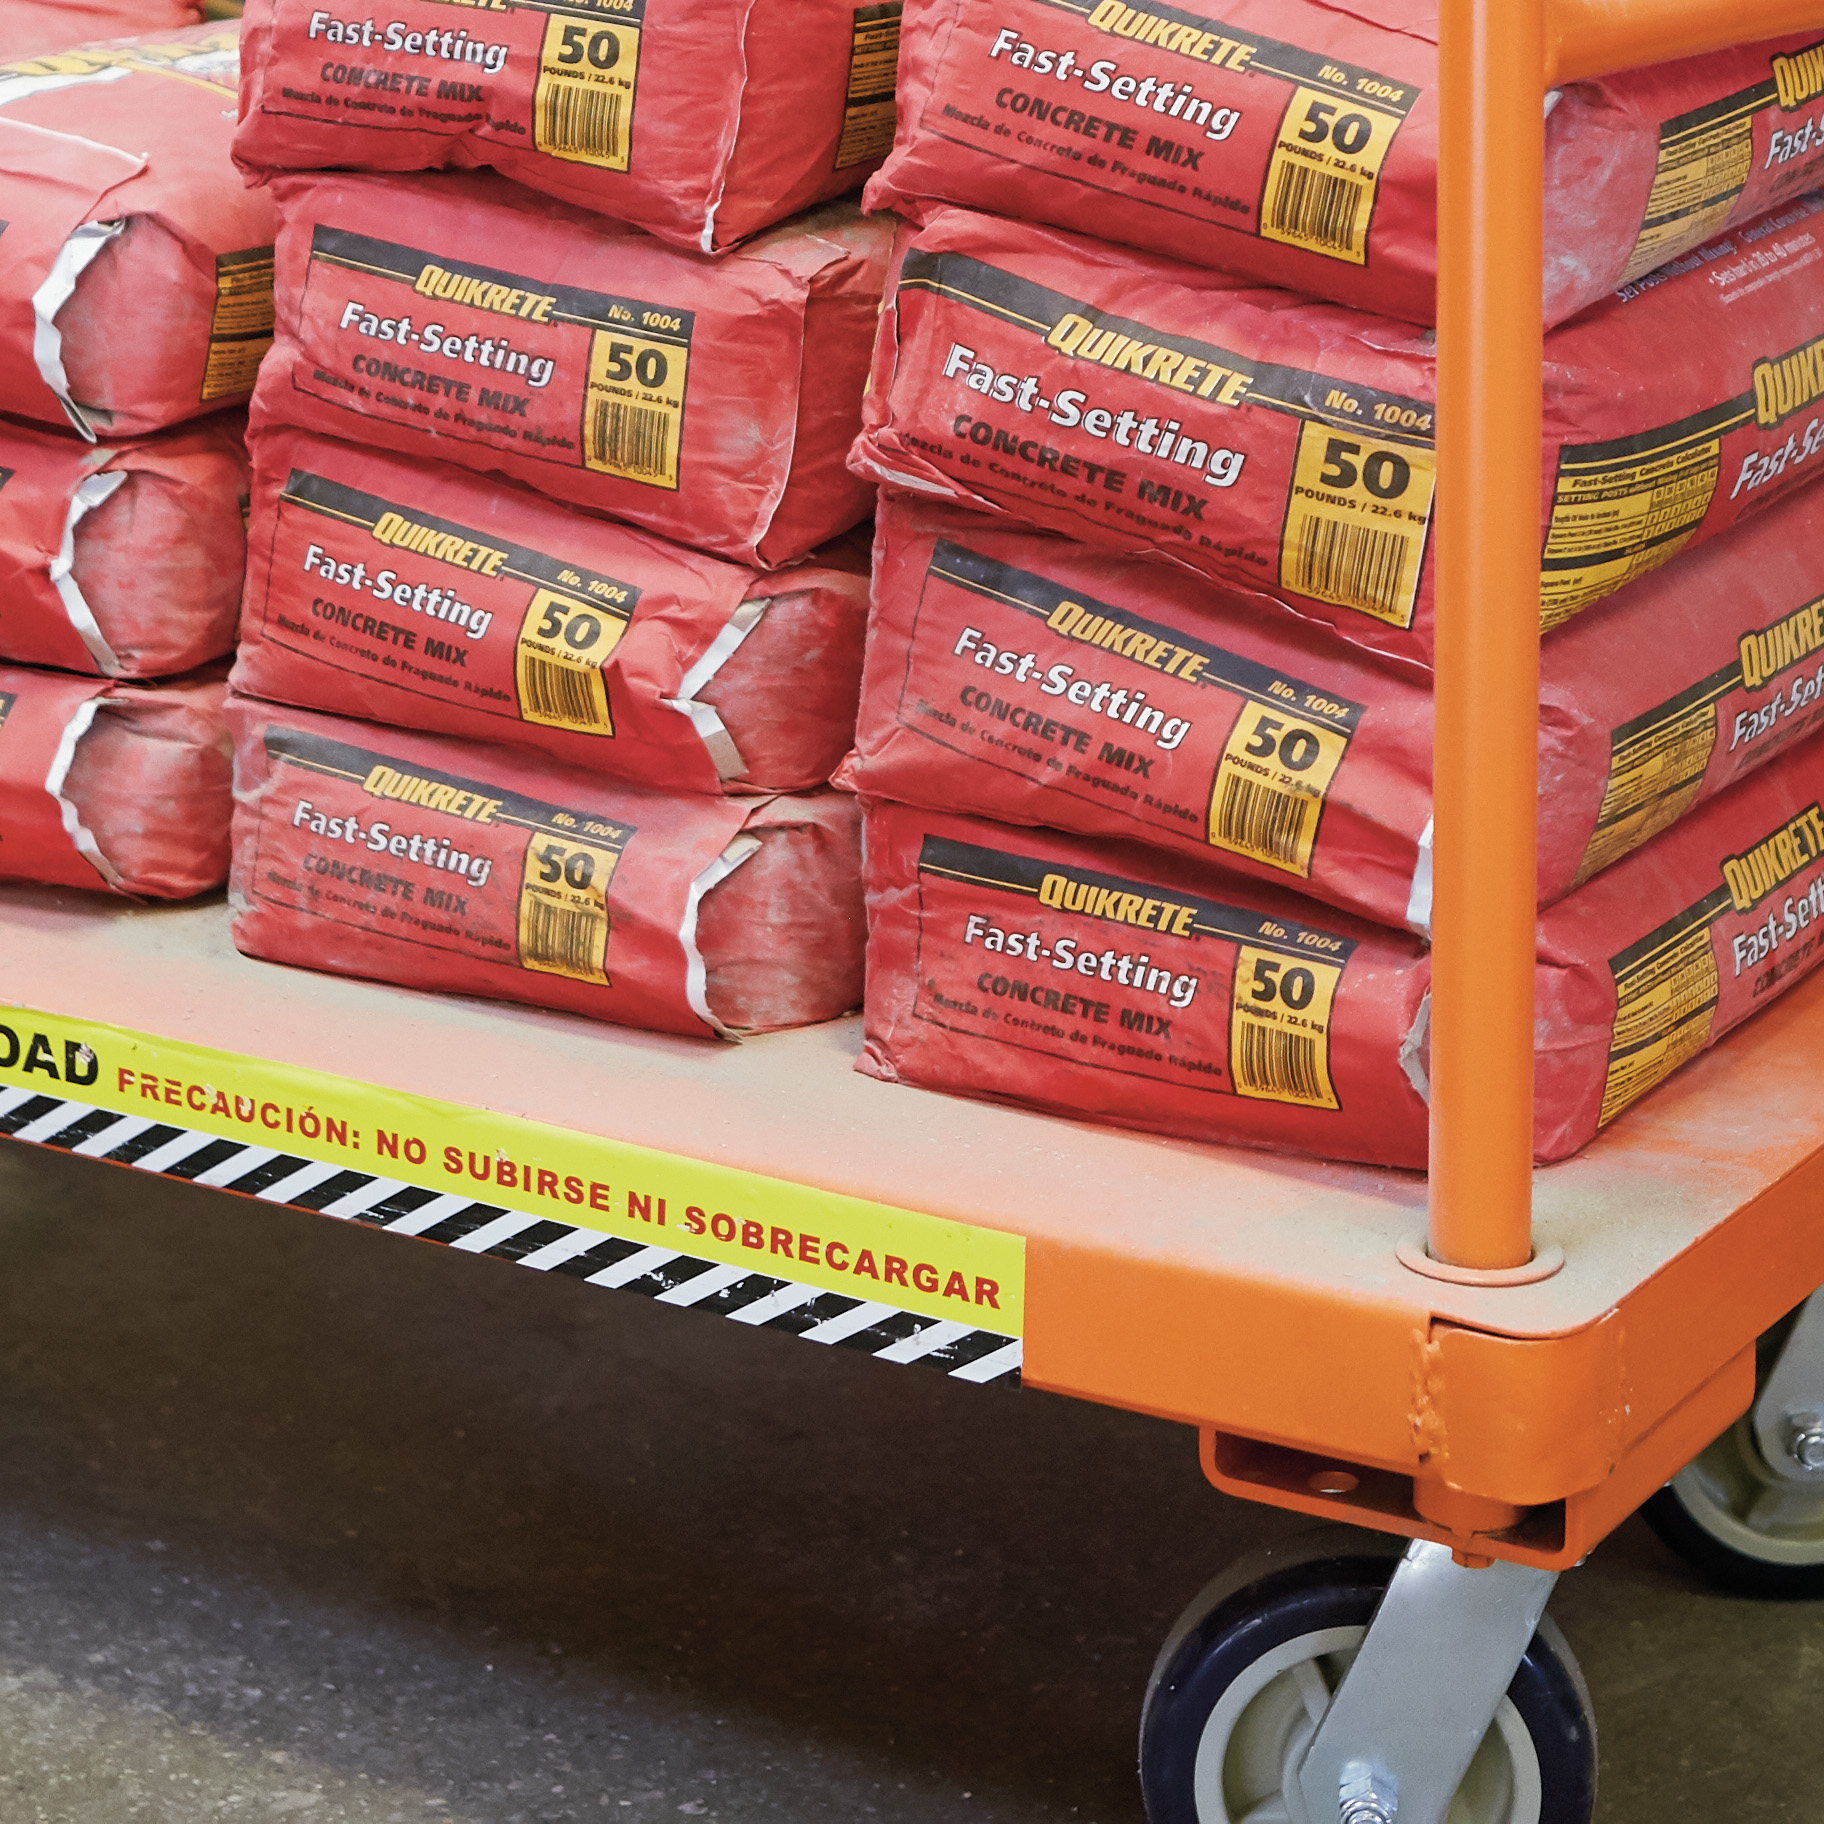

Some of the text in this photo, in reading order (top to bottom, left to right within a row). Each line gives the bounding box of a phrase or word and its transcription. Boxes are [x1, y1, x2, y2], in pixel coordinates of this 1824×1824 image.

[308, 11, 509, 74] Fast-Setting
[557, 26, 621, 71] 50
[989, 28, 1242, 142] Fast-Setting
[1298, 101, 1373, 155] 50
[415, 263, 557, 324] QUIKRETE
[339, 301, 554, 389] Fast-Setting
[606, 342, 668, 388] 50
[1044, 312, 1254, 408] QUIKRETE
[943, 341, 1246, 488] Fast-Setting
[1320, 437, 1412, 500] 50
[372, 511, 508, 577] QUIKRETE
[303, 544, 493, 640] Fast-Setting
[536, 601, 602, 650] 50
[1046, 600, 1211, 684] QUIKRETE
[954, 627, 1193, 751] Fast-Setting
[1243, 713, 1322, 772] 50
[363, 765, 503, 825] QUIKRETE
[292, 800, 493, 887] Fast-Setting
[538, 844, 597, 890] 50
[1037, 874, 1199, 937] QUIKRETE
[963, 914, 1199, 1009] Fast-Setting
[1251, 959, 1317, 1011] 50
[117, 1067, 360, 1151] PRECAUCIÓN:
[377, 1129, 427, 1166] NO
[443, 1146, 610, 1212] SUBIRSE
[628, 1190, 667, 1226] NI
[684, 1205, 1001, 1311] SOBRECARGAR
